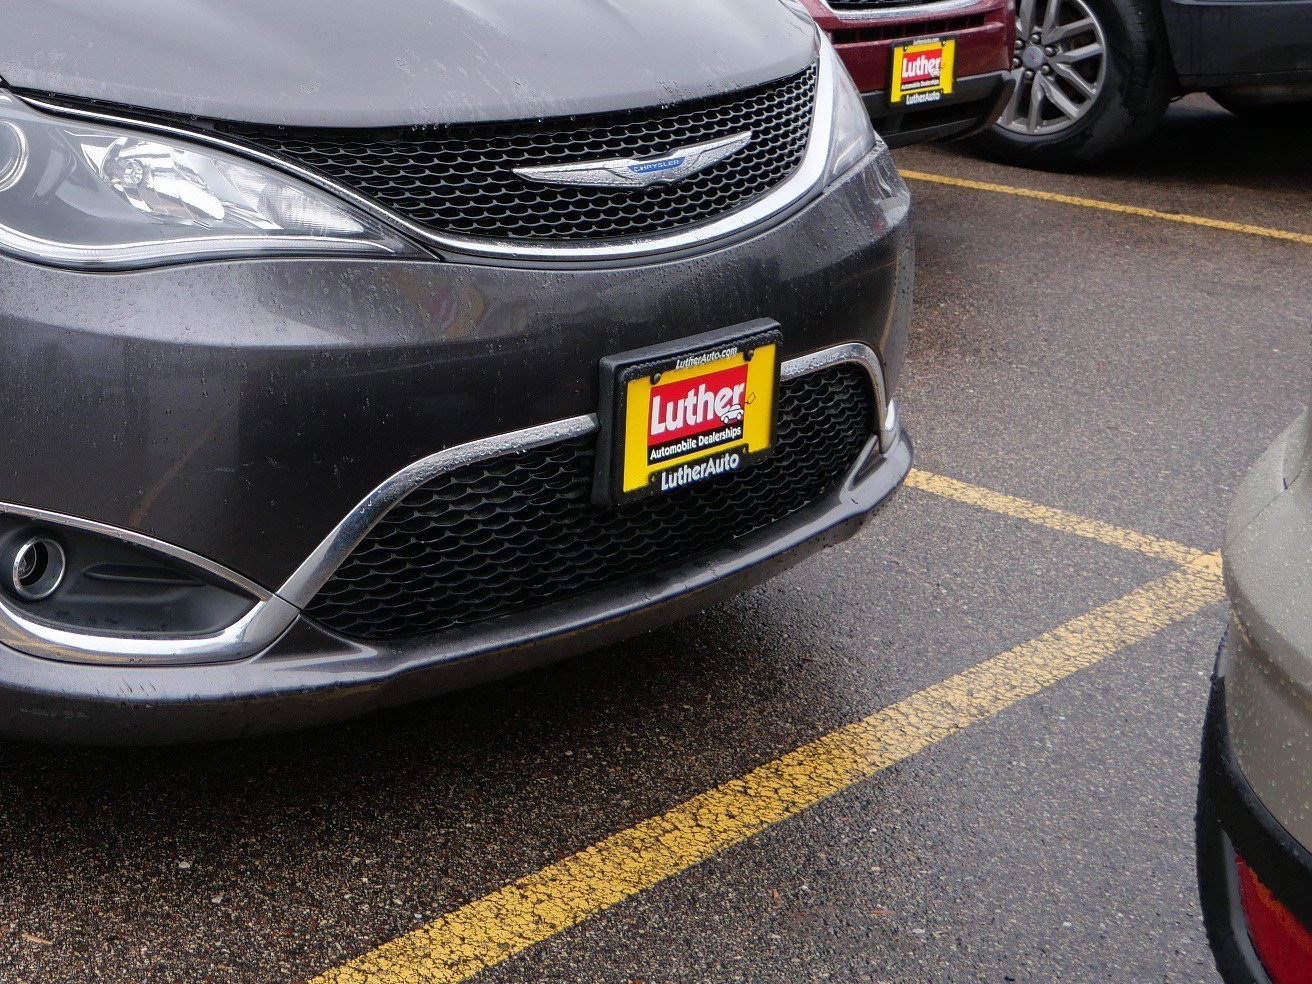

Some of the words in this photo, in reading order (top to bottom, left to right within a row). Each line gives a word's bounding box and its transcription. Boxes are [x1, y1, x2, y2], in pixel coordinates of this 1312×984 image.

[902, 55, 941, 78] Luther
[633, 160, 679, 172] CHRYSLER
[675, 347, 737, 370] LutherAuto.com
[650, 383, 745, 436] Luther
[650, 437, 697, 460] Automobile
[698, 426, 741, 447] Dealerships
[661, 453, 739, 491] LutherAuto
